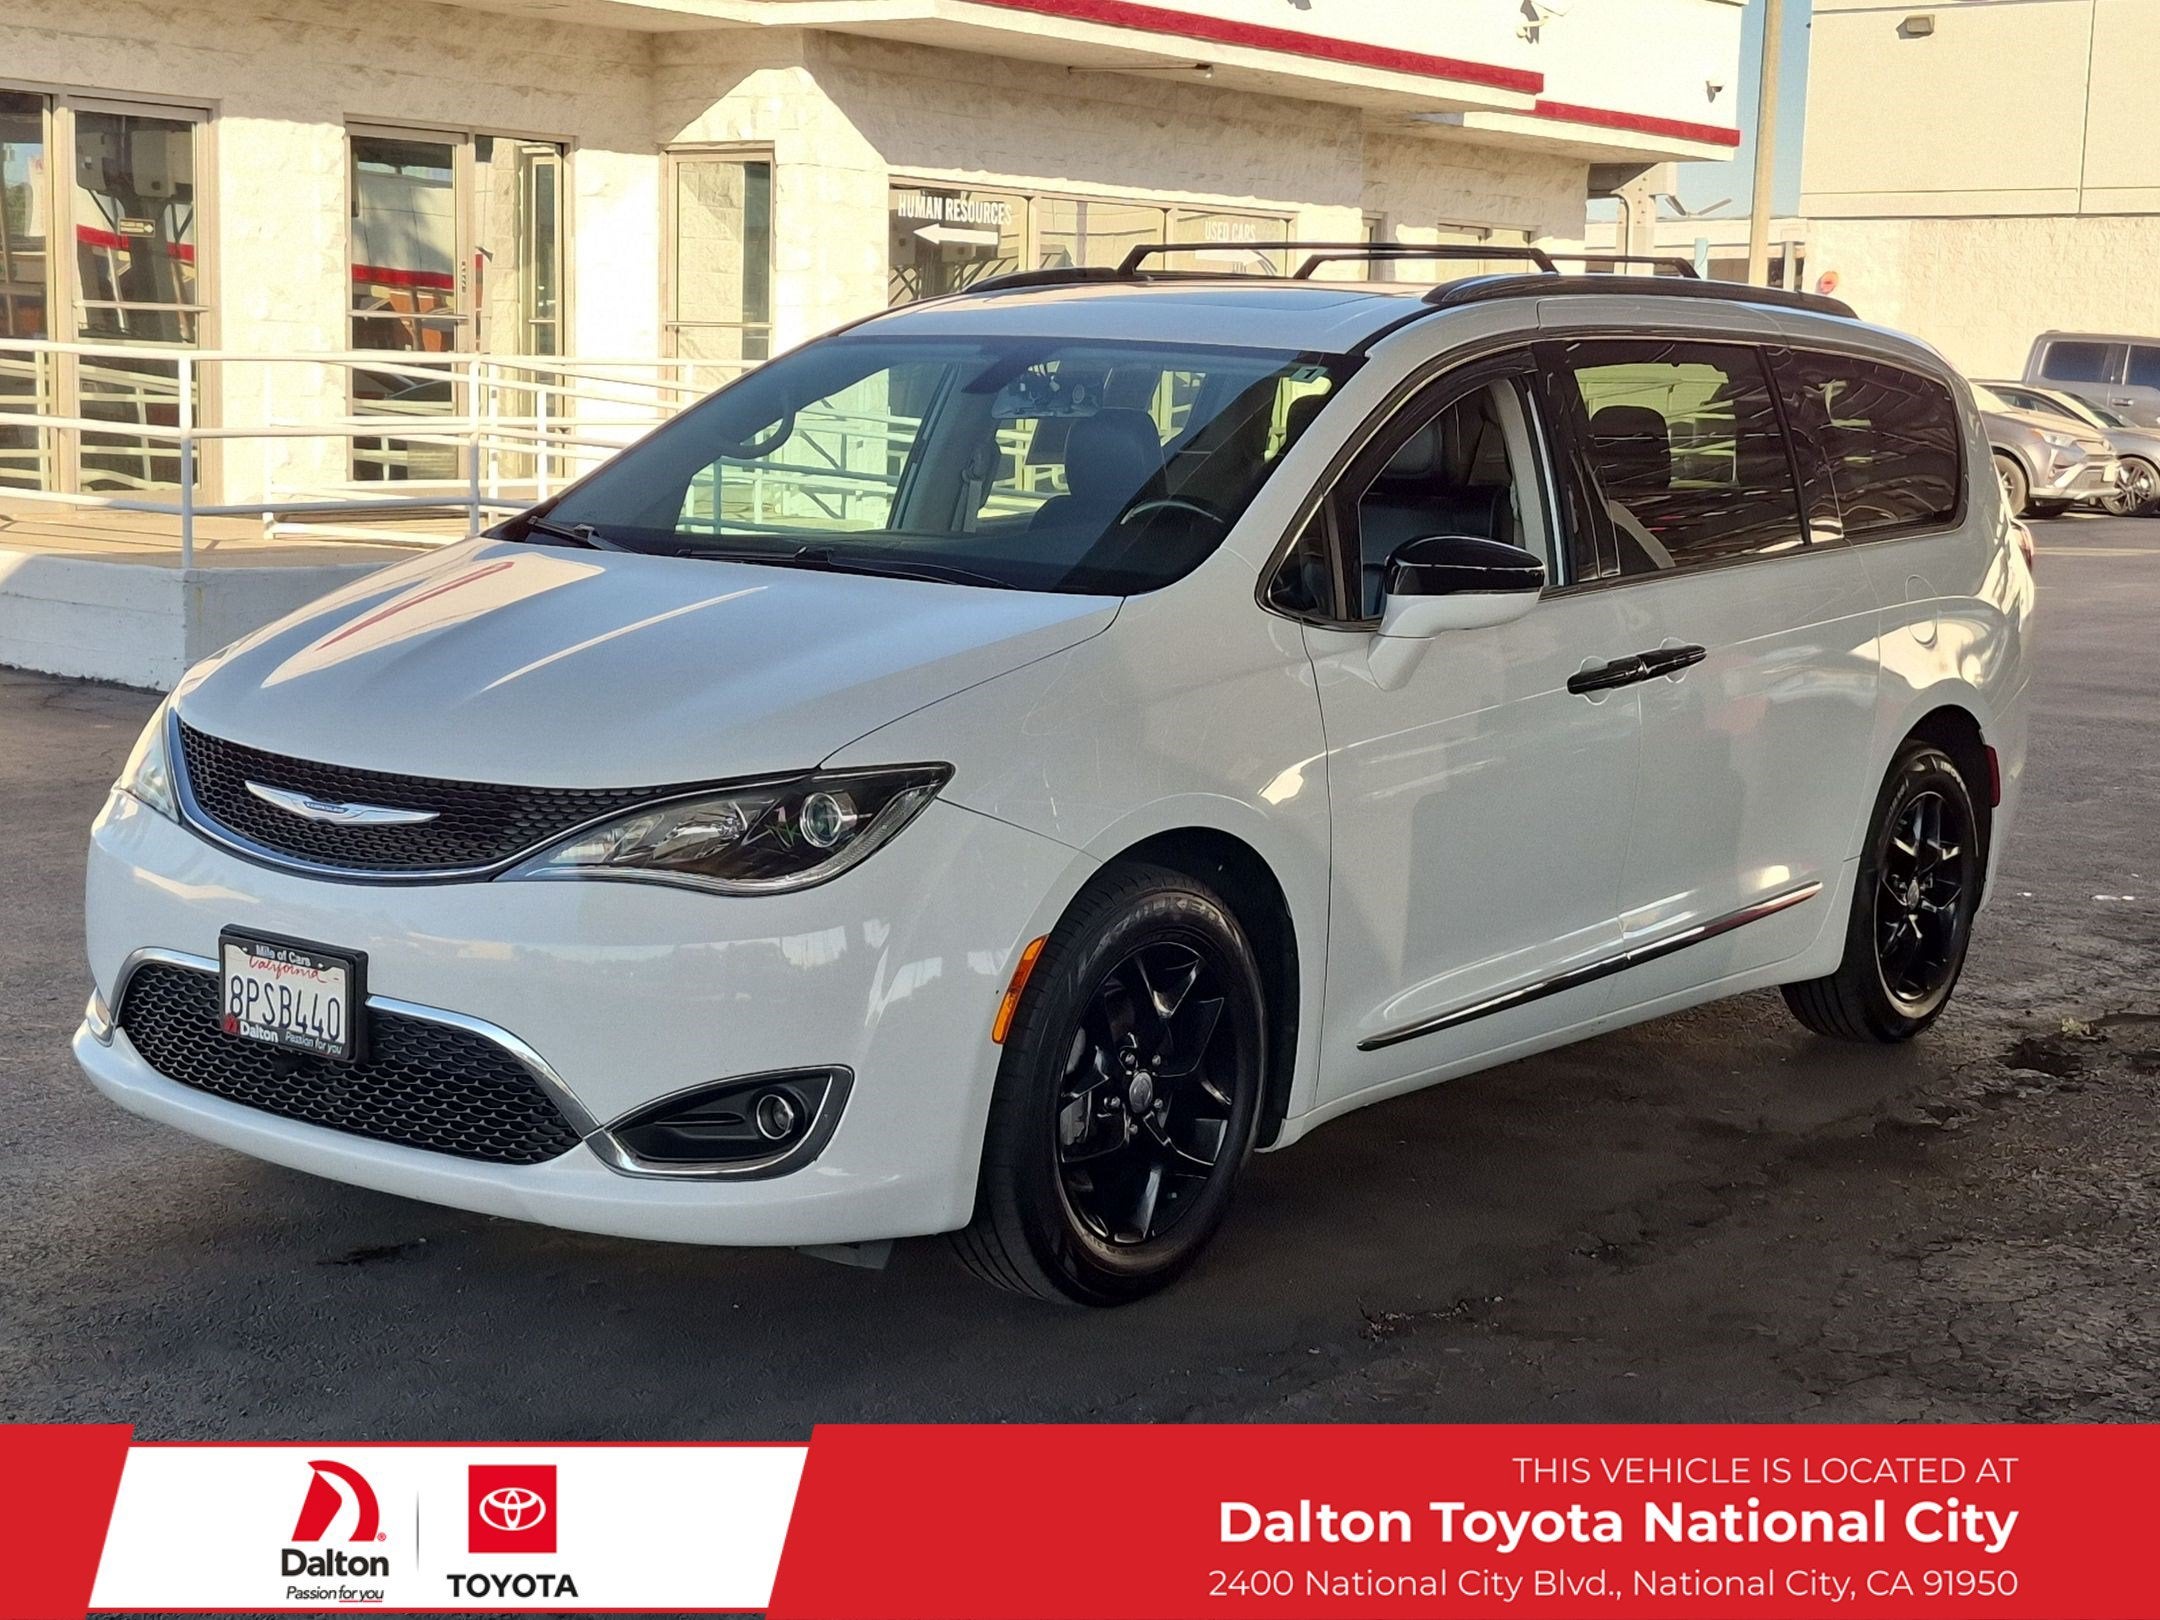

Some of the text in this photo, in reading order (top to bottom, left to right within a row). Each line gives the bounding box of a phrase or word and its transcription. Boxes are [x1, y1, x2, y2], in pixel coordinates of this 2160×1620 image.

[897, 193, 1012, 225] HUMAN RESOURCES
[1204, 221, 1256, 240] USED CARS
[256, 944, 311, 966] Mile of Cars
[230, 975, 341, 1042] 8PSB440
[240, 1021, 342, 1054] Dalton Passion for you
